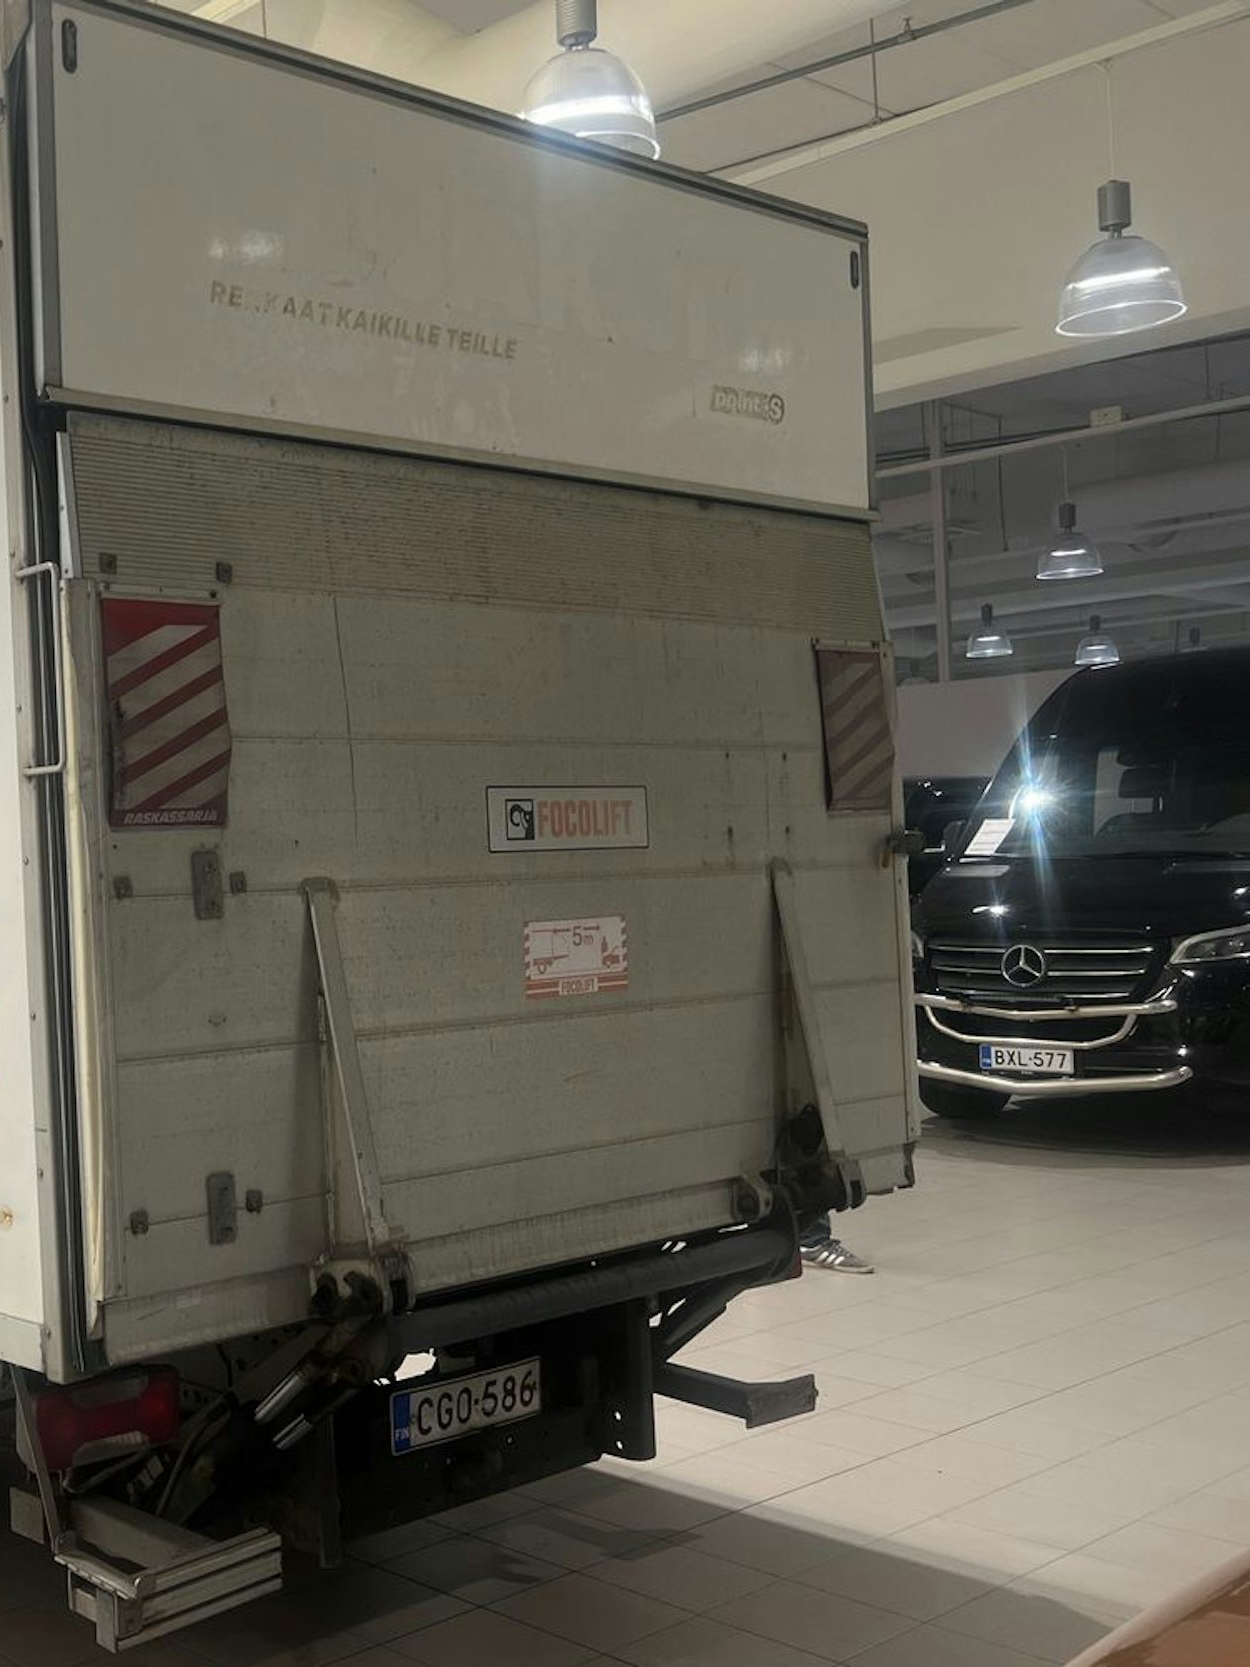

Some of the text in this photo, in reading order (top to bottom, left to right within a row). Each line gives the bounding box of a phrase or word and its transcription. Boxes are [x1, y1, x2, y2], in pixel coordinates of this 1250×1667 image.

[210, 280, 518, 360] REAAT KAIKILLE TEILLE
[537, 800, 633, 838] FOCOLIFT
[995, 1050, 1067, 1069] BXL-577
[417, 1369, 535, 1436] CGO-586
